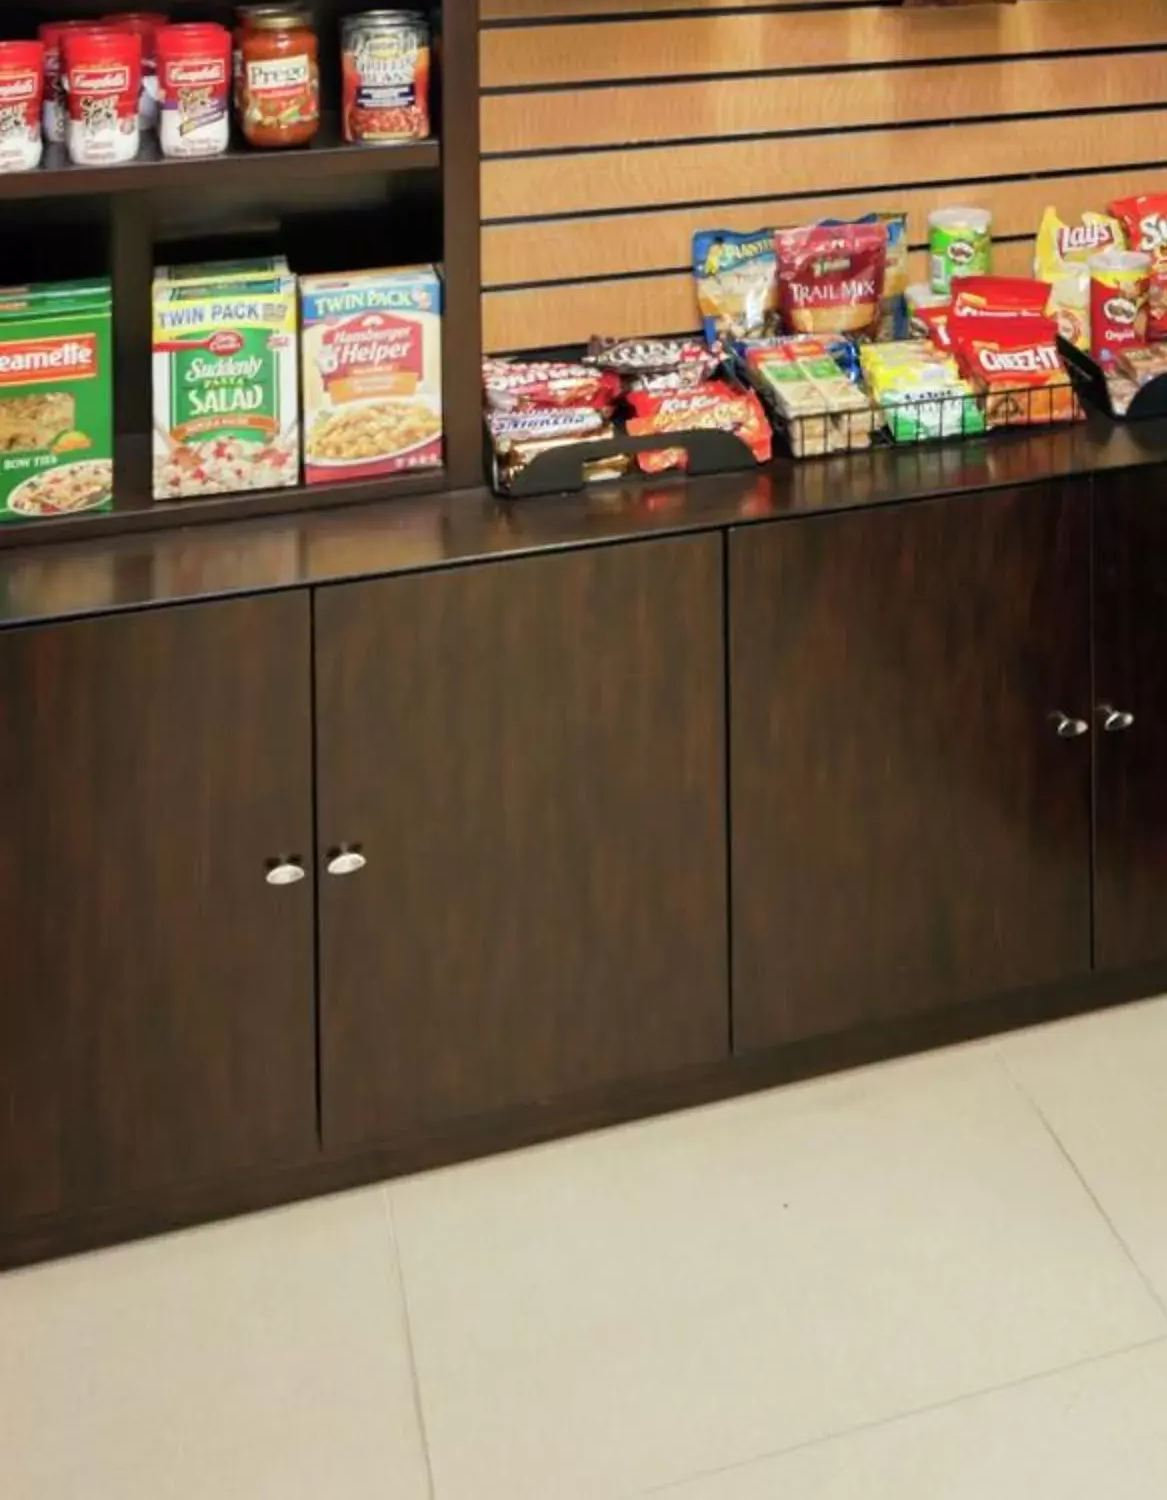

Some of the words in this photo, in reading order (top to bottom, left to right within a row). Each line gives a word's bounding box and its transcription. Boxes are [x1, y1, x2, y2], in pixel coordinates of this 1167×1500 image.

[251, 63, 306, 86] Prego
[789, 281, 836, 301] TRAIL
[838, 279, 876, 300] MIX
[314, 295, 366, 315] TWIN
[366, 290, 412, 308] PACK
[158, 305, 205, 329] TWIN
[211, 302, 259, 321] PACK
[332, 327, 413, 343] Hamburger
[341, 342, 411, 366] Helper
[185, 356, 263, 382] Suddenly
[188, 384, 263, 416] SALAD
